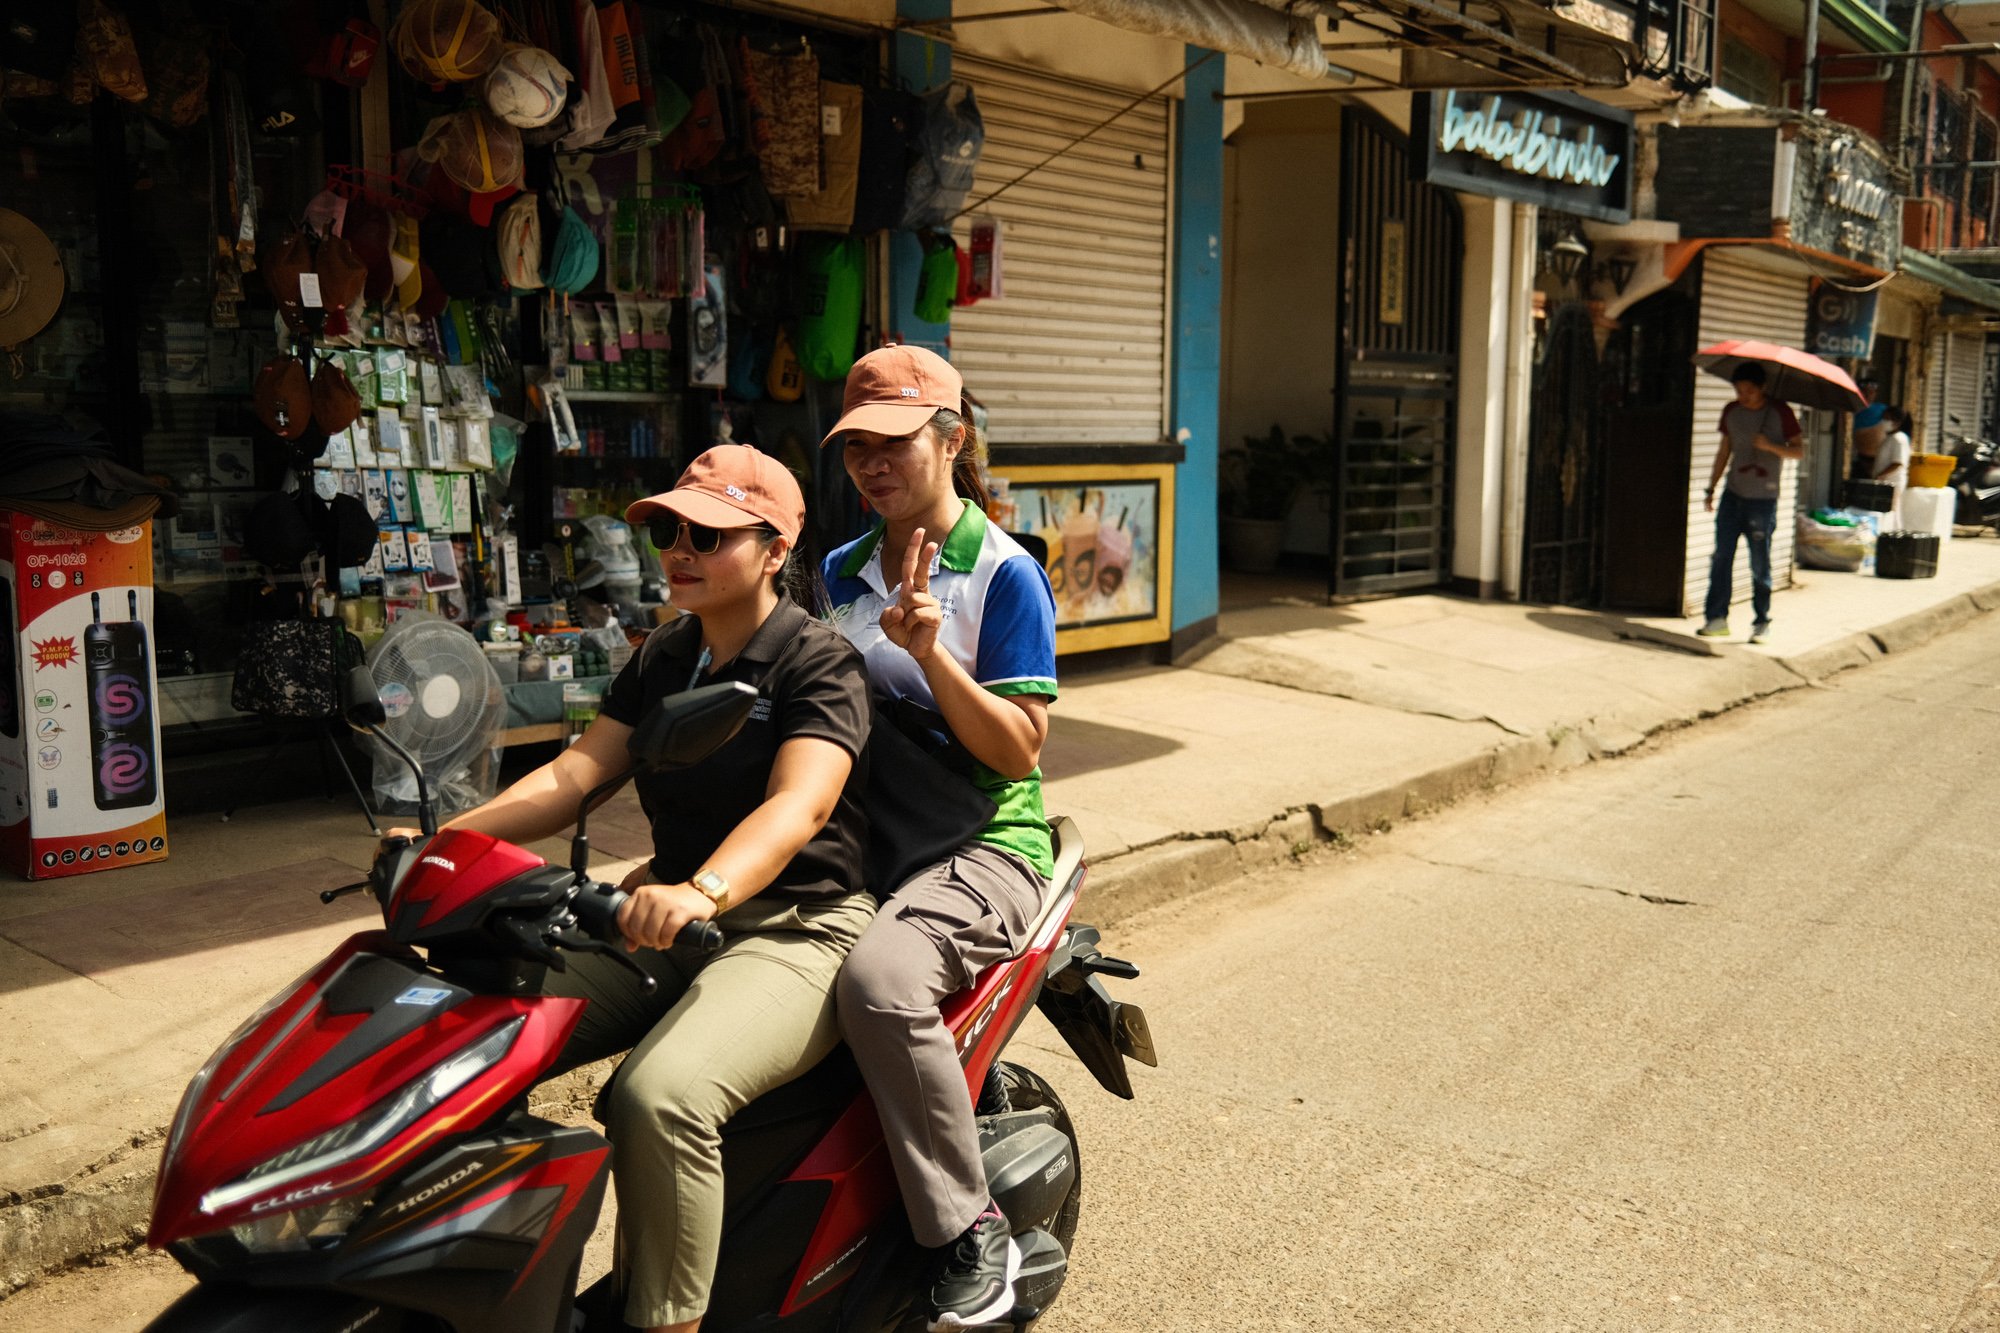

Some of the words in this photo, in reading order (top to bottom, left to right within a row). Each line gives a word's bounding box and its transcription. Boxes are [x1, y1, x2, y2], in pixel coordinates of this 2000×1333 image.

[27, 553, 87, 568] OP-1026
[41, 651, 71, 662] 18000W
[421, 856, 455, 871] HONDA
[958, 976, 1013, 1057] ICK
[250, 1180, 334, 1213] CLICK
[398, 1161, 484, 1213] HONDA
